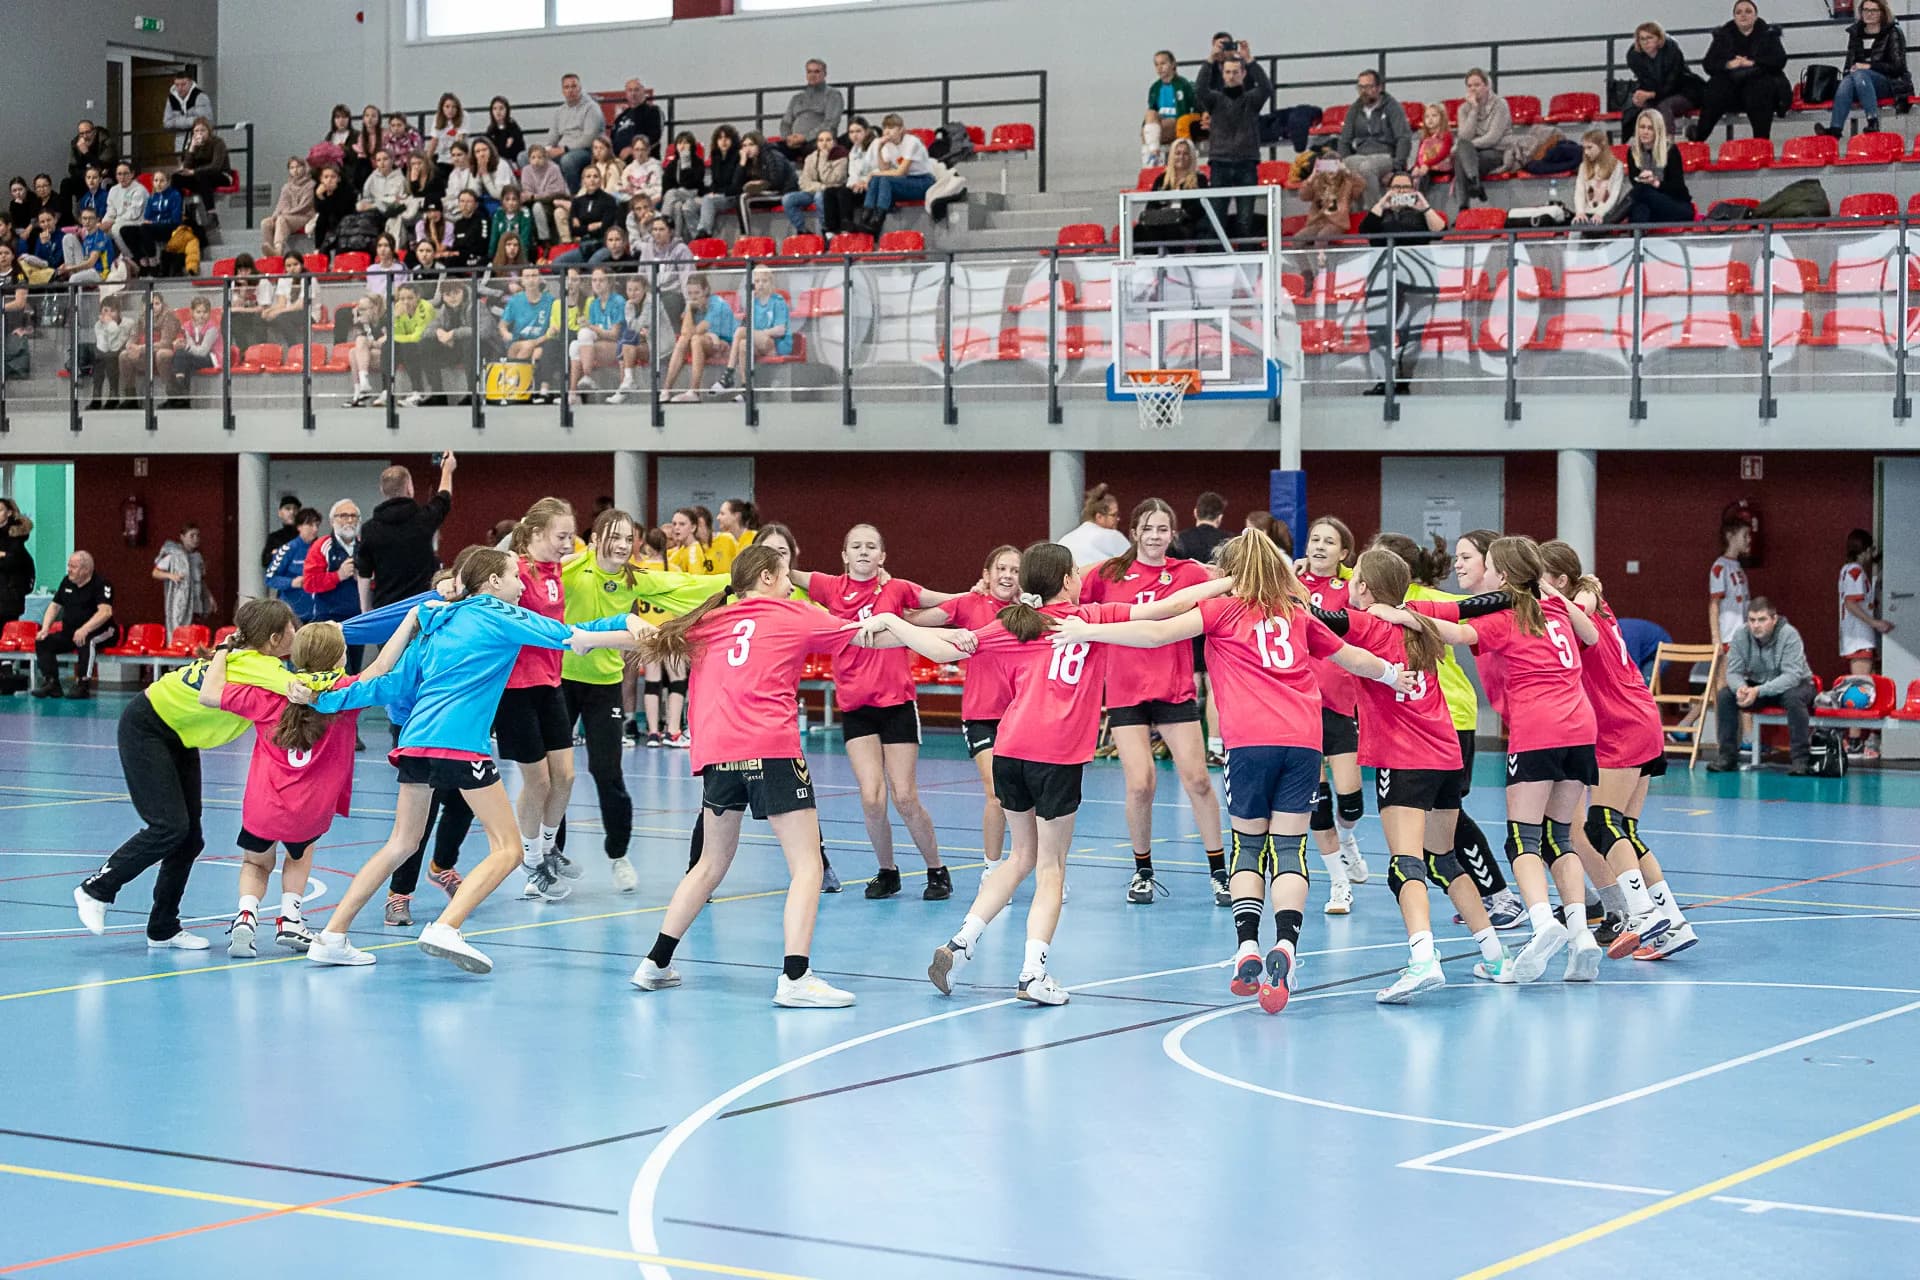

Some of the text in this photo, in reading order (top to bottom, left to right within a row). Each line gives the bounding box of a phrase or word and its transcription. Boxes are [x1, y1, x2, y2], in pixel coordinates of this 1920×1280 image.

[727, 618, 756, 667] 3
[1047, 641, 1090, 685] 18
[1254, 616, 1294, 669] 13
[1544, 620, 1574, 669] 5
